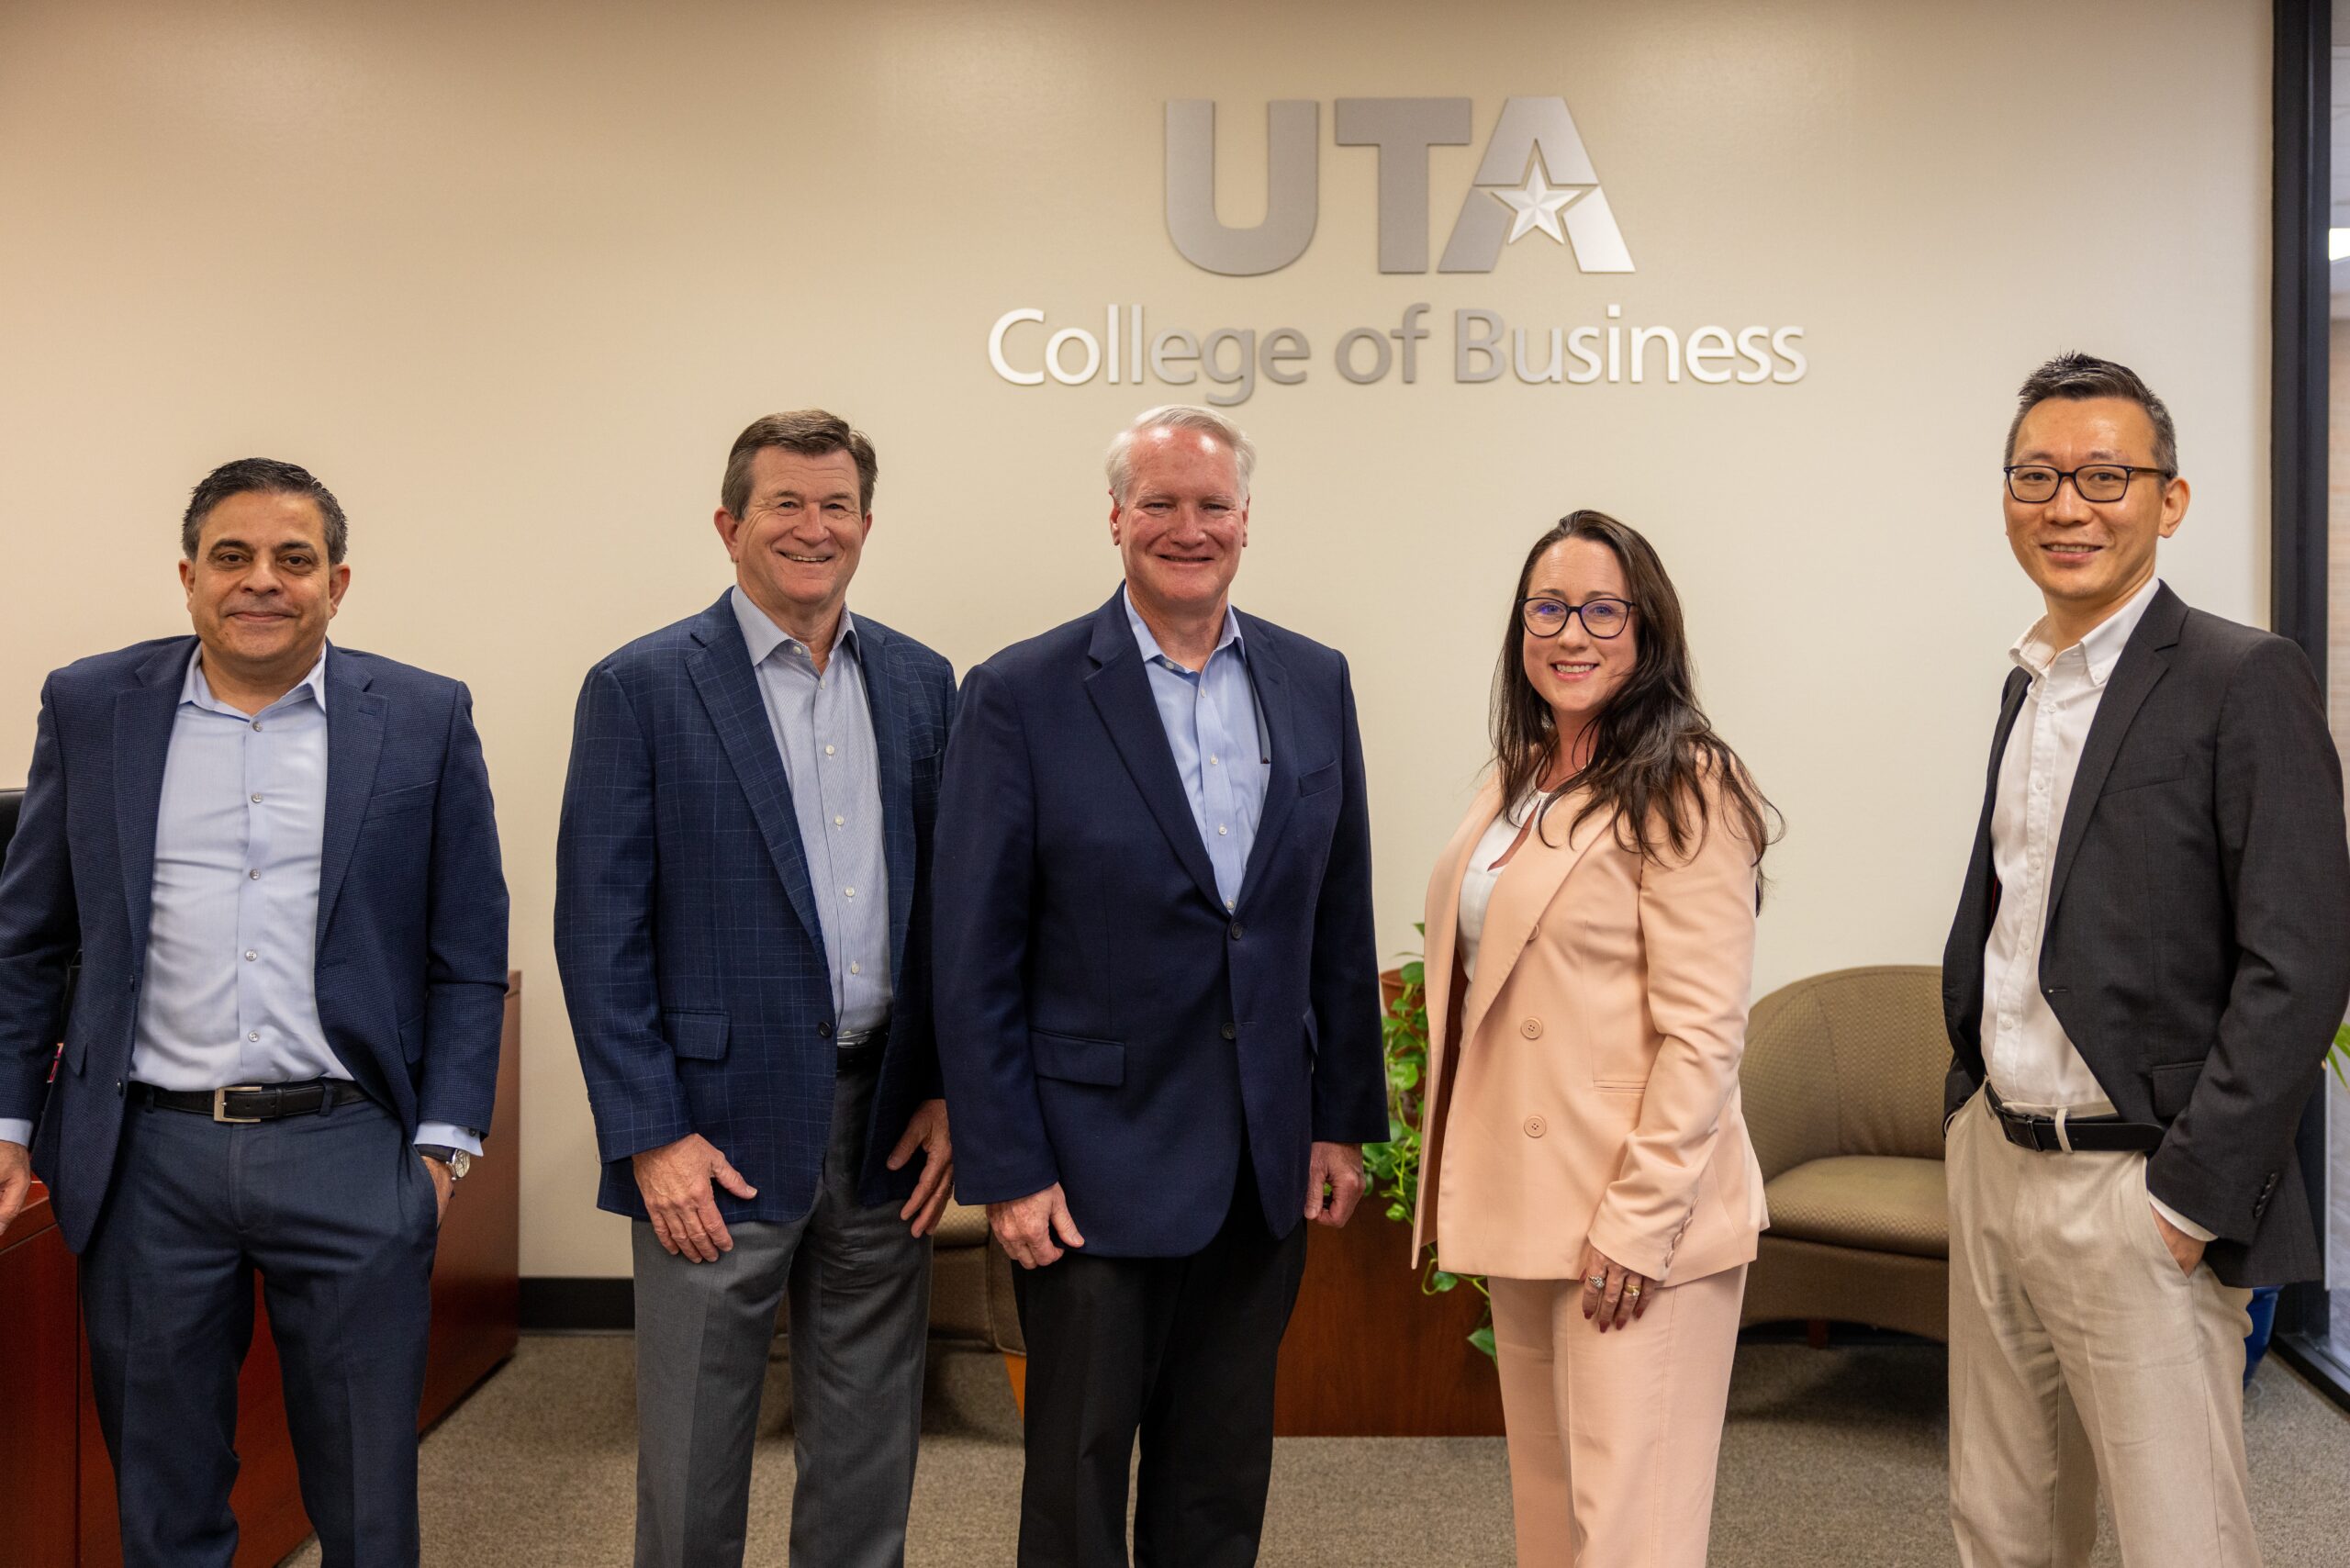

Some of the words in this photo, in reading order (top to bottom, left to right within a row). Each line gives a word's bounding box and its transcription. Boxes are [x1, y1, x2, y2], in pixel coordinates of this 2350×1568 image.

[1165, 96, 1637, 276] UTA
[988, 304, 1311, 407] College
[1335, 303, 1431, 385] of
[1454, 304, 1809, 385] Business
